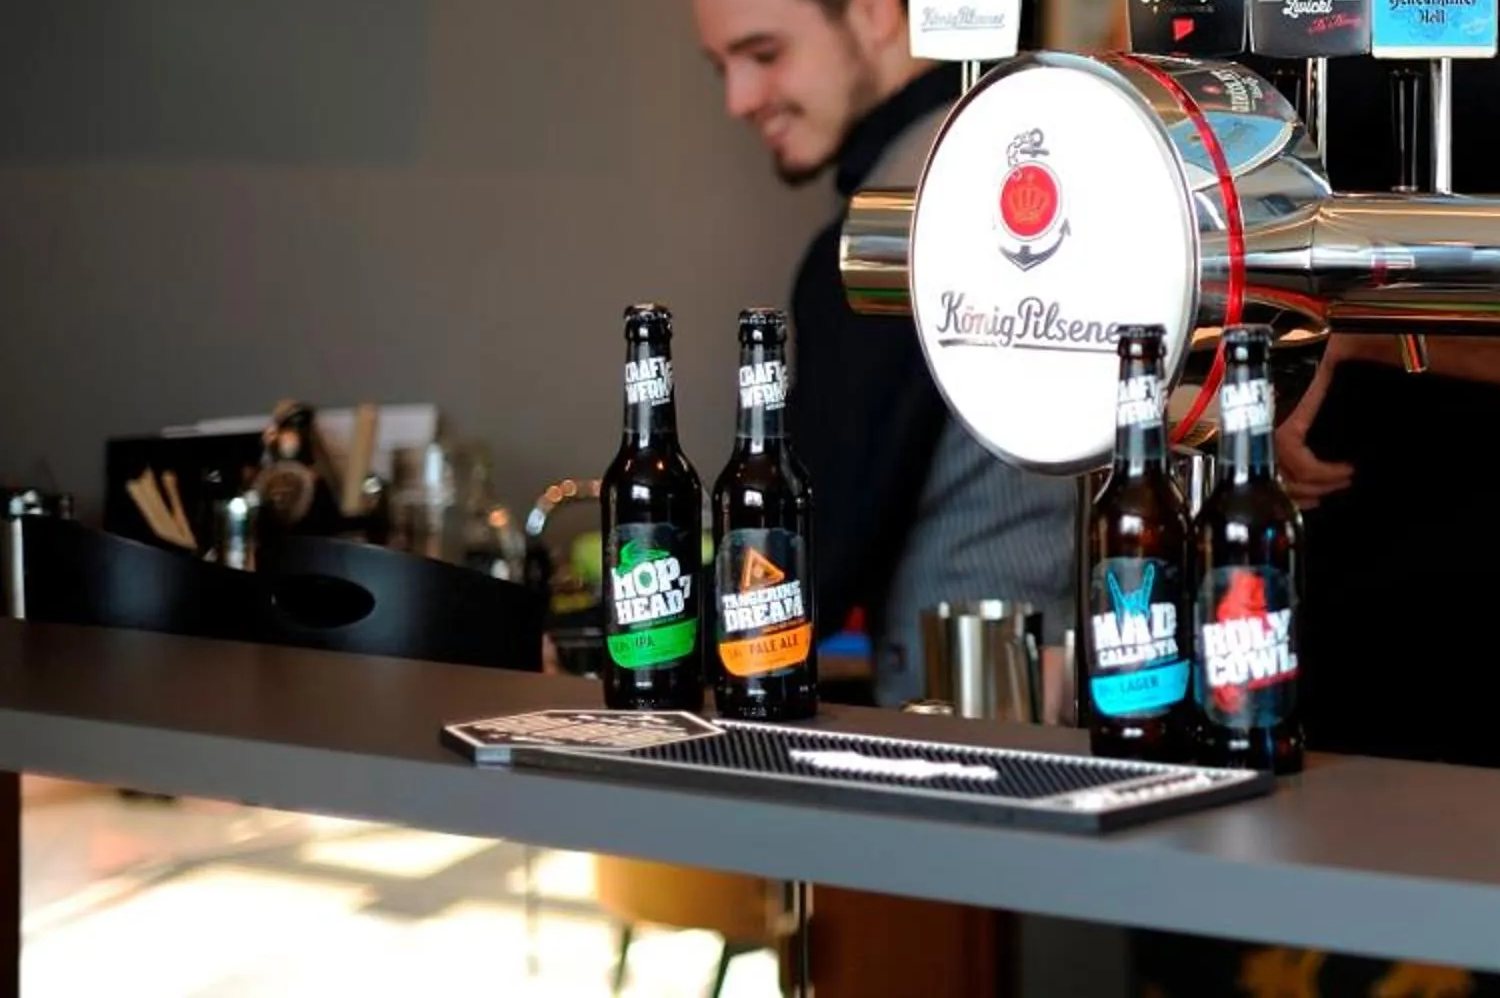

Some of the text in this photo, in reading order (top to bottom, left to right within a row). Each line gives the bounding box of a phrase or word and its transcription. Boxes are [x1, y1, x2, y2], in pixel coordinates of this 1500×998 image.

[937, 290, 1122, 347] König Pilsene
[611, 557, 681, 601] HOP
[723, 596, 804, 633] DREAM
[749, 642, 777, 654] PALE
[780, 633, 800, 649] ALE
